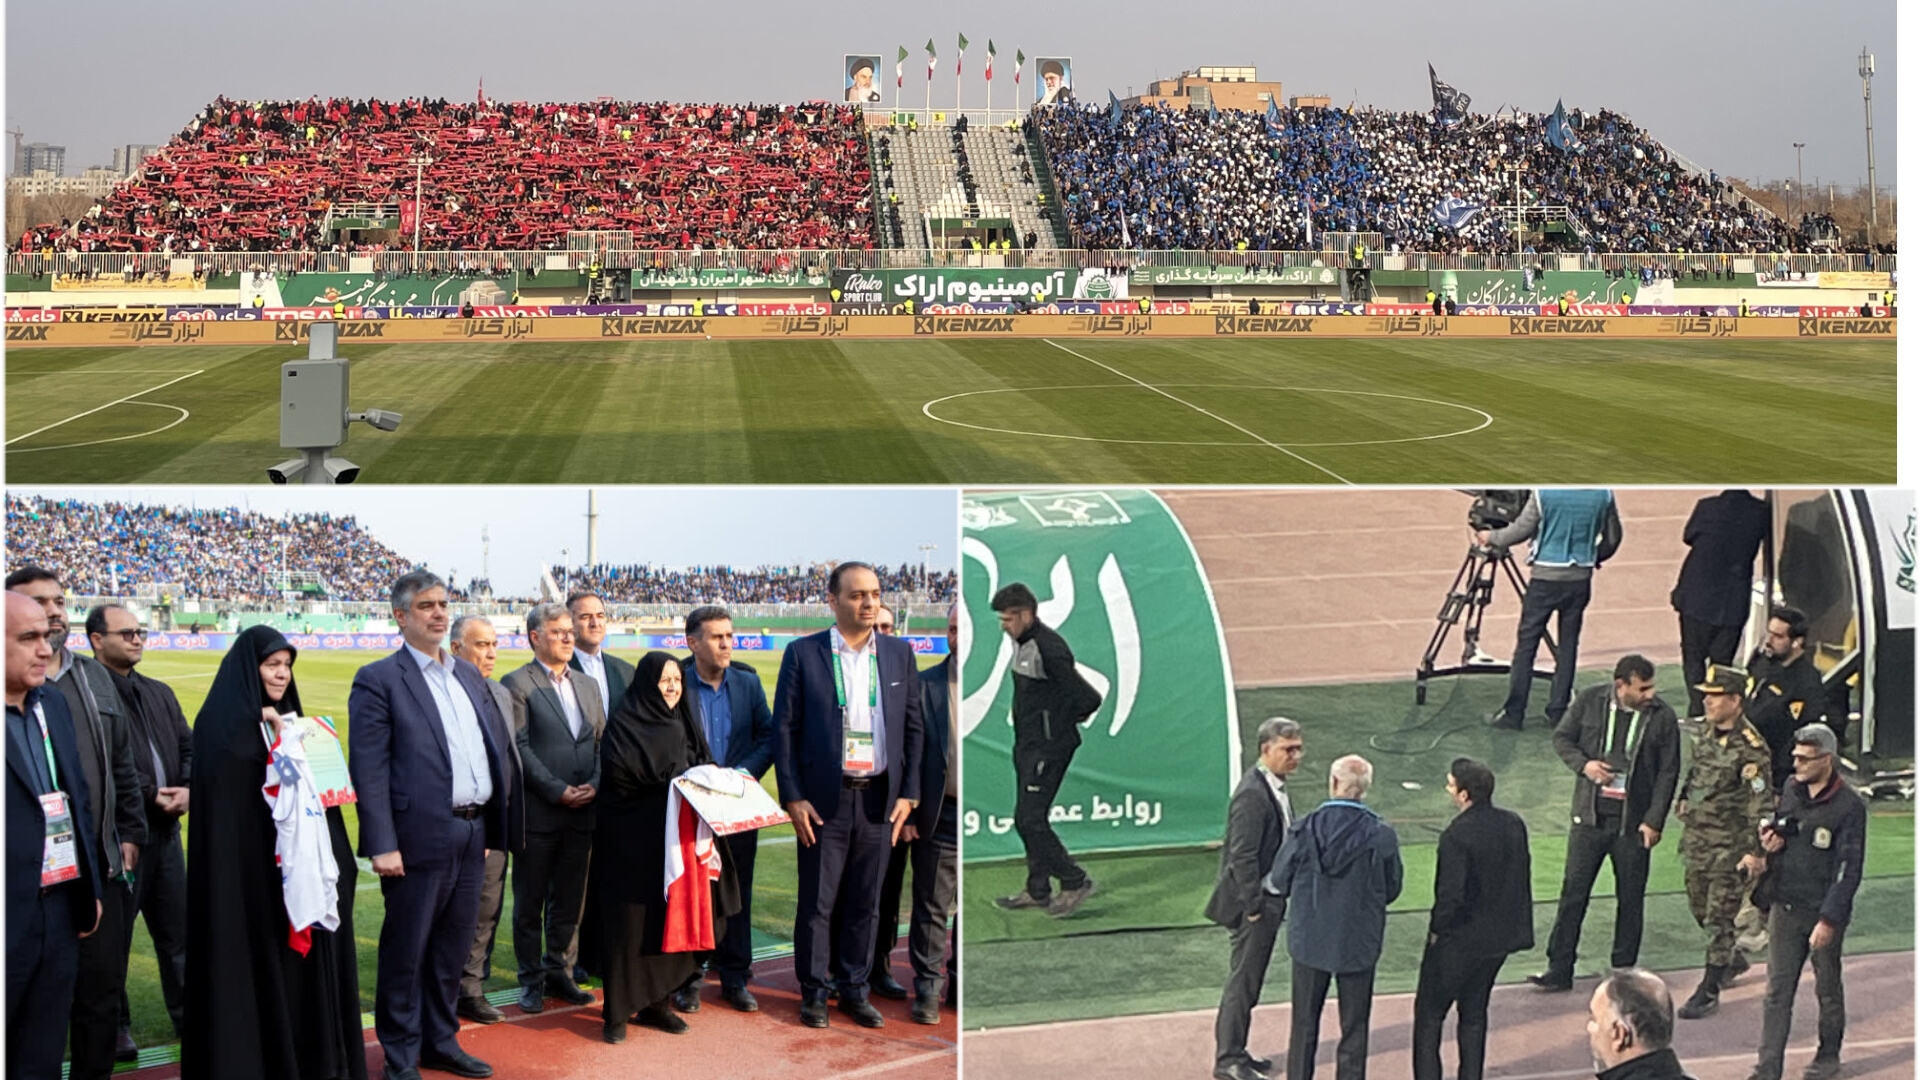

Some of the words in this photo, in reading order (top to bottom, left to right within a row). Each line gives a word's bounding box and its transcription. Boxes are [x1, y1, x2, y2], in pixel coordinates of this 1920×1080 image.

[640, 273, 688, 287] شهیدان
[690, 276, 698, 287] و
[699, 273, 738, 287] امیران
[1155, 268, 1192, 283] گذاری
[1193, 270, 1232, 284] سرمایه
[1234, 270, 1254, 284] امن
[894, 274, 944, 303] اراک
[947, 271, 1065, 302] آلومینیوم
[1467, 278, 1517, 304] فرزانگان
[844, 293, 865, 302] SPORT
[865, 293, 883, 302] CLUB
[86, 312, 164, 322] KENZAX
[173, 322, 204, 343] ابزار
[300, 322, 386, 337] KNZAX
[504, 319, 533, 339] ابزار
[625, 319, 706, 334] KENZAX
[820, 317, 848, 336] ابزار
[936, 318, 1015, 332] KENZAX
[1124, 316, 1152, 335] ابزار
[1237, 318, 1314, 332] KENZAX
[1421, 316, 1448, 336] ابزار
[1531, 319, 1607, 334] KENZAX
[1711, 317, 1738, 337] ابزار
[1819, 320, 1893, 335] KENZAX
[175, 633, 209, 648] نادری
[289, 634, 319, 648] نادری
[323, 634, 354, 648] نادری
[357, 634, 387, 648] نادری
[740, 635, 763, 649] نادری
[1091, 794, 1161, 827] روابط
[963, 810, 980, 836] و
